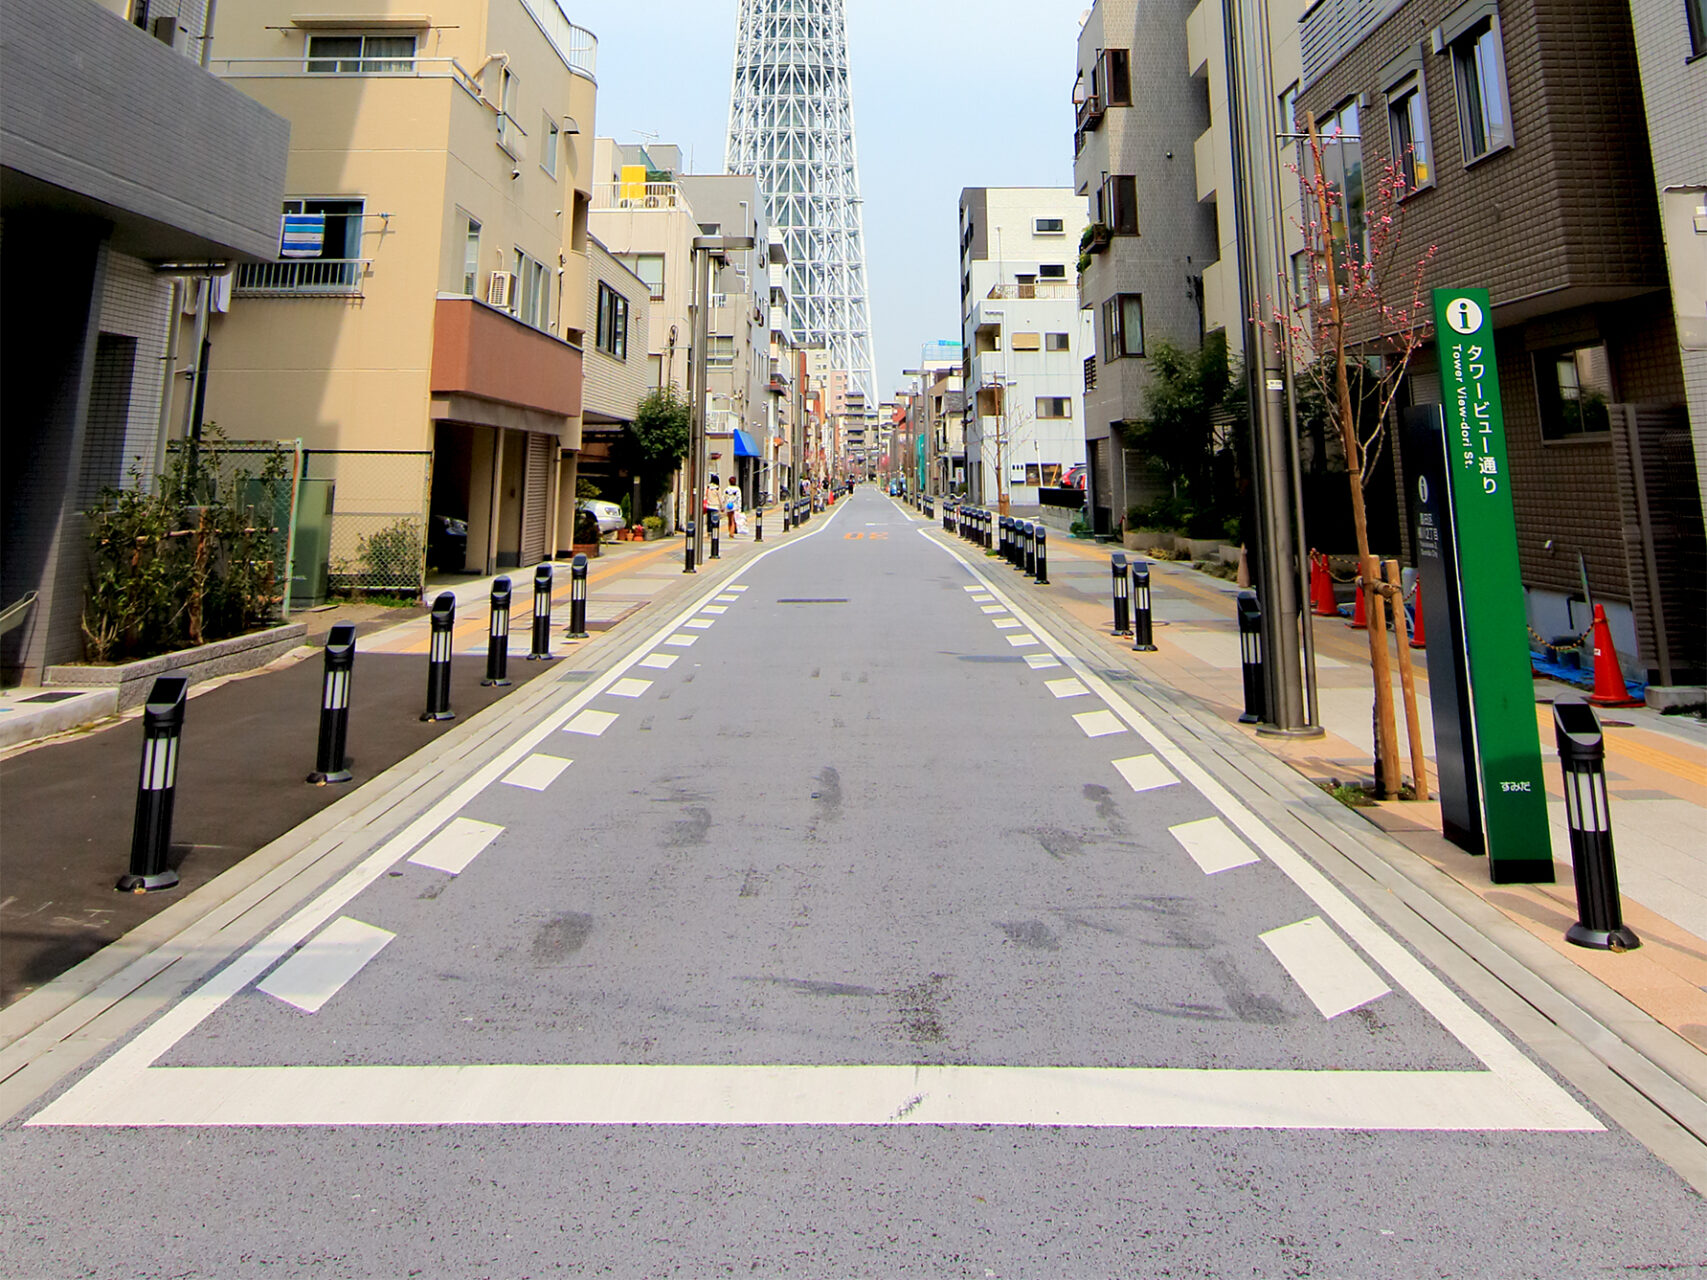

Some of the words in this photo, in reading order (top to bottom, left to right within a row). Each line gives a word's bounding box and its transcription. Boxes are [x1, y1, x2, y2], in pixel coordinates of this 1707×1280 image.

[1452, 343, 1464, 383] Tower
[1457, 387, 1474, 447] View-dori
[1467, 344, 1498, 495] タワービュー通り
[1463, 450, 1475, 469] St.
